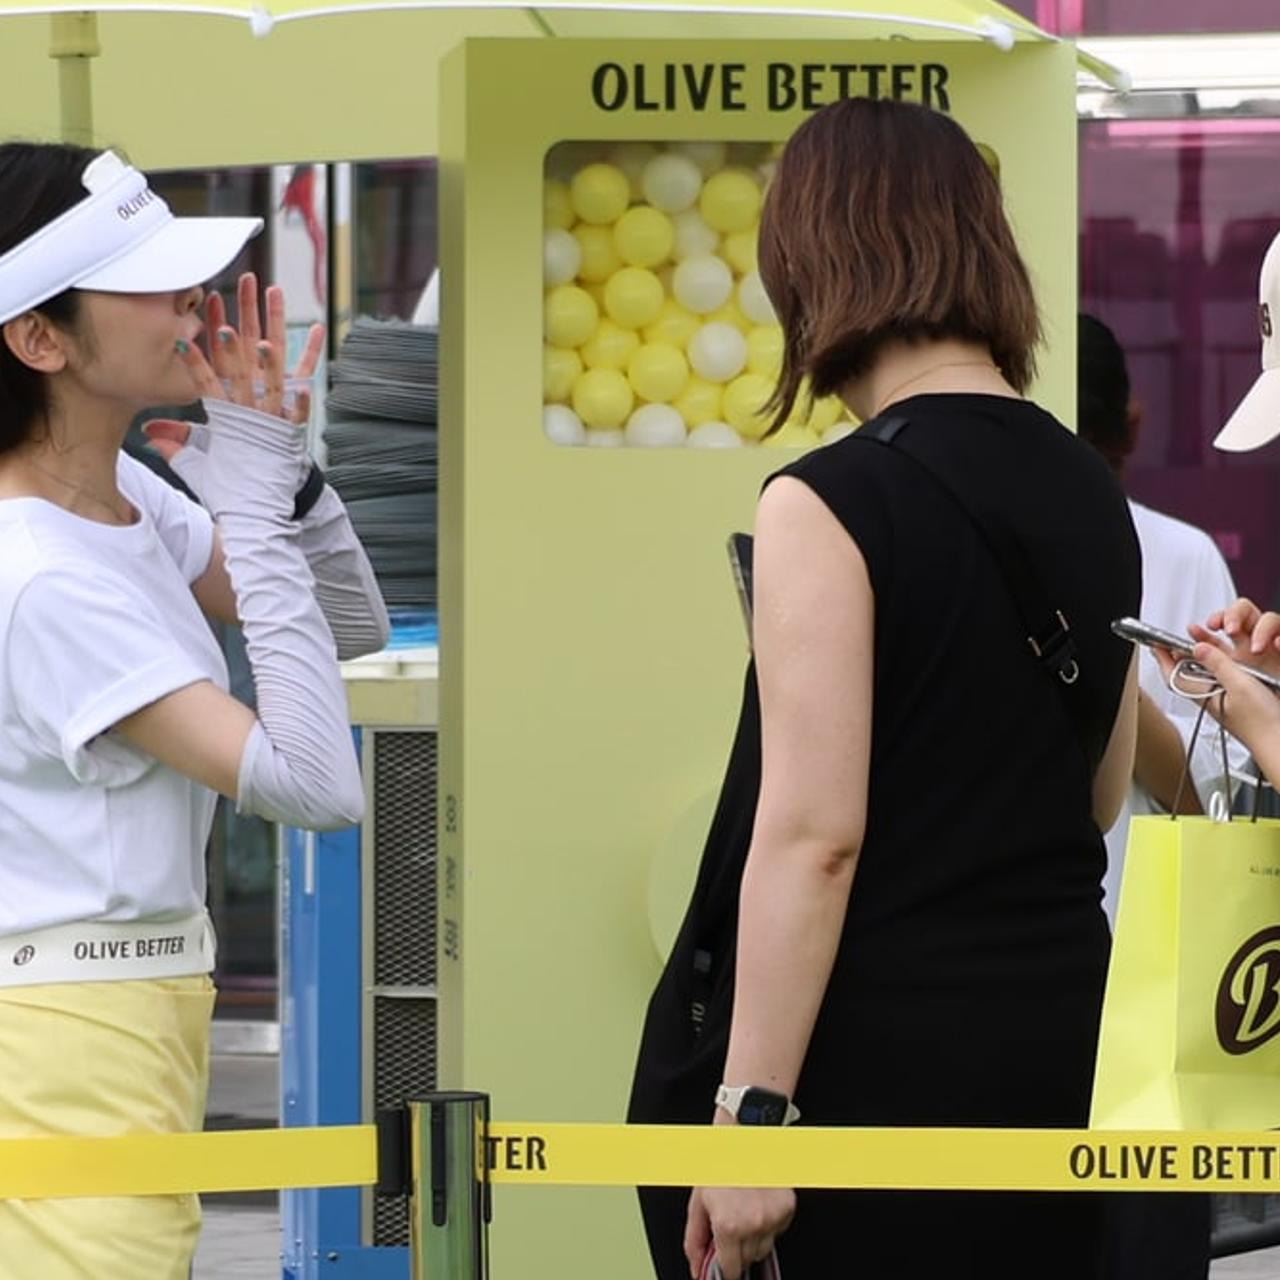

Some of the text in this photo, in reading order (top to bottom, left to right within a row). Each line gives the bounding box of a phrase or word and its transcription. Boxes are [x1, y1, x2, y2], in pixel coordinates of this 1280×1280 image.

[591, 62, 950, 112] OLIVE BETTER
[73, 941, 131, 961] OLIVE
[136, 935, 185, 959] BETTER
[1069, 1144, 1179, 1180] OLIVE
